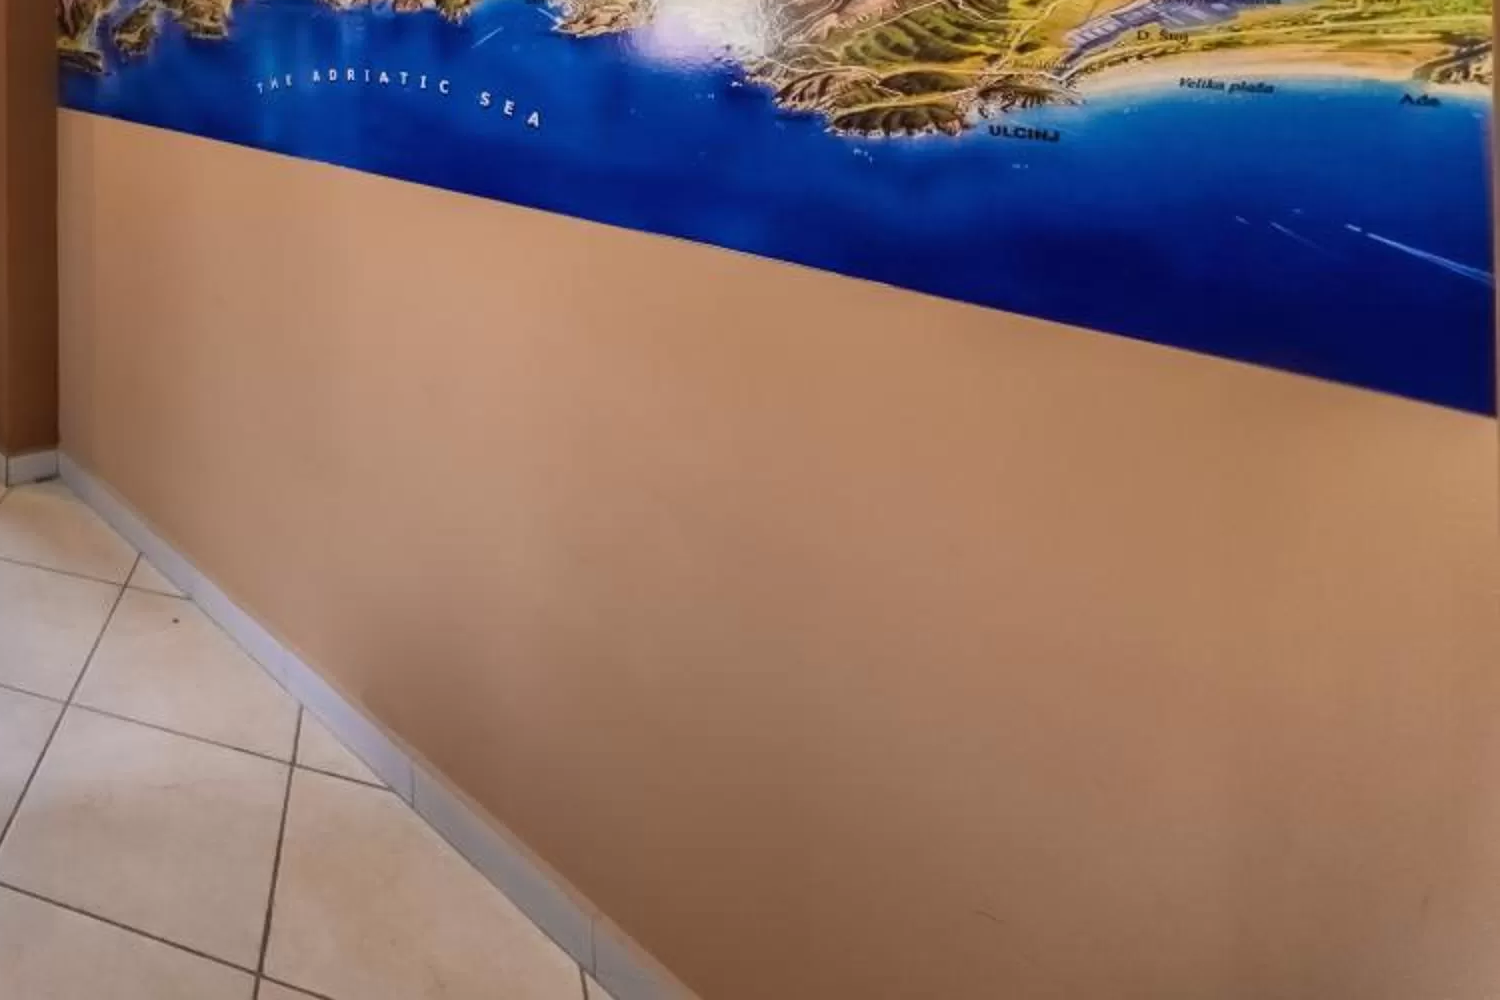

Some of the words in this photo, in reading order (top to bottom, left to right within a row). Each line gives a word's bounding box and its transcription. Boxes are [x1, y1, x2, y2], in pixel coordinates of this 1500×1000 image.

[256, 74, 294, 95] THE
[312, 67, 450, 95] ADRIATIC
[479, 90, 541, 128] SEA
[987, 124, 1061, 143] ULCINJ
